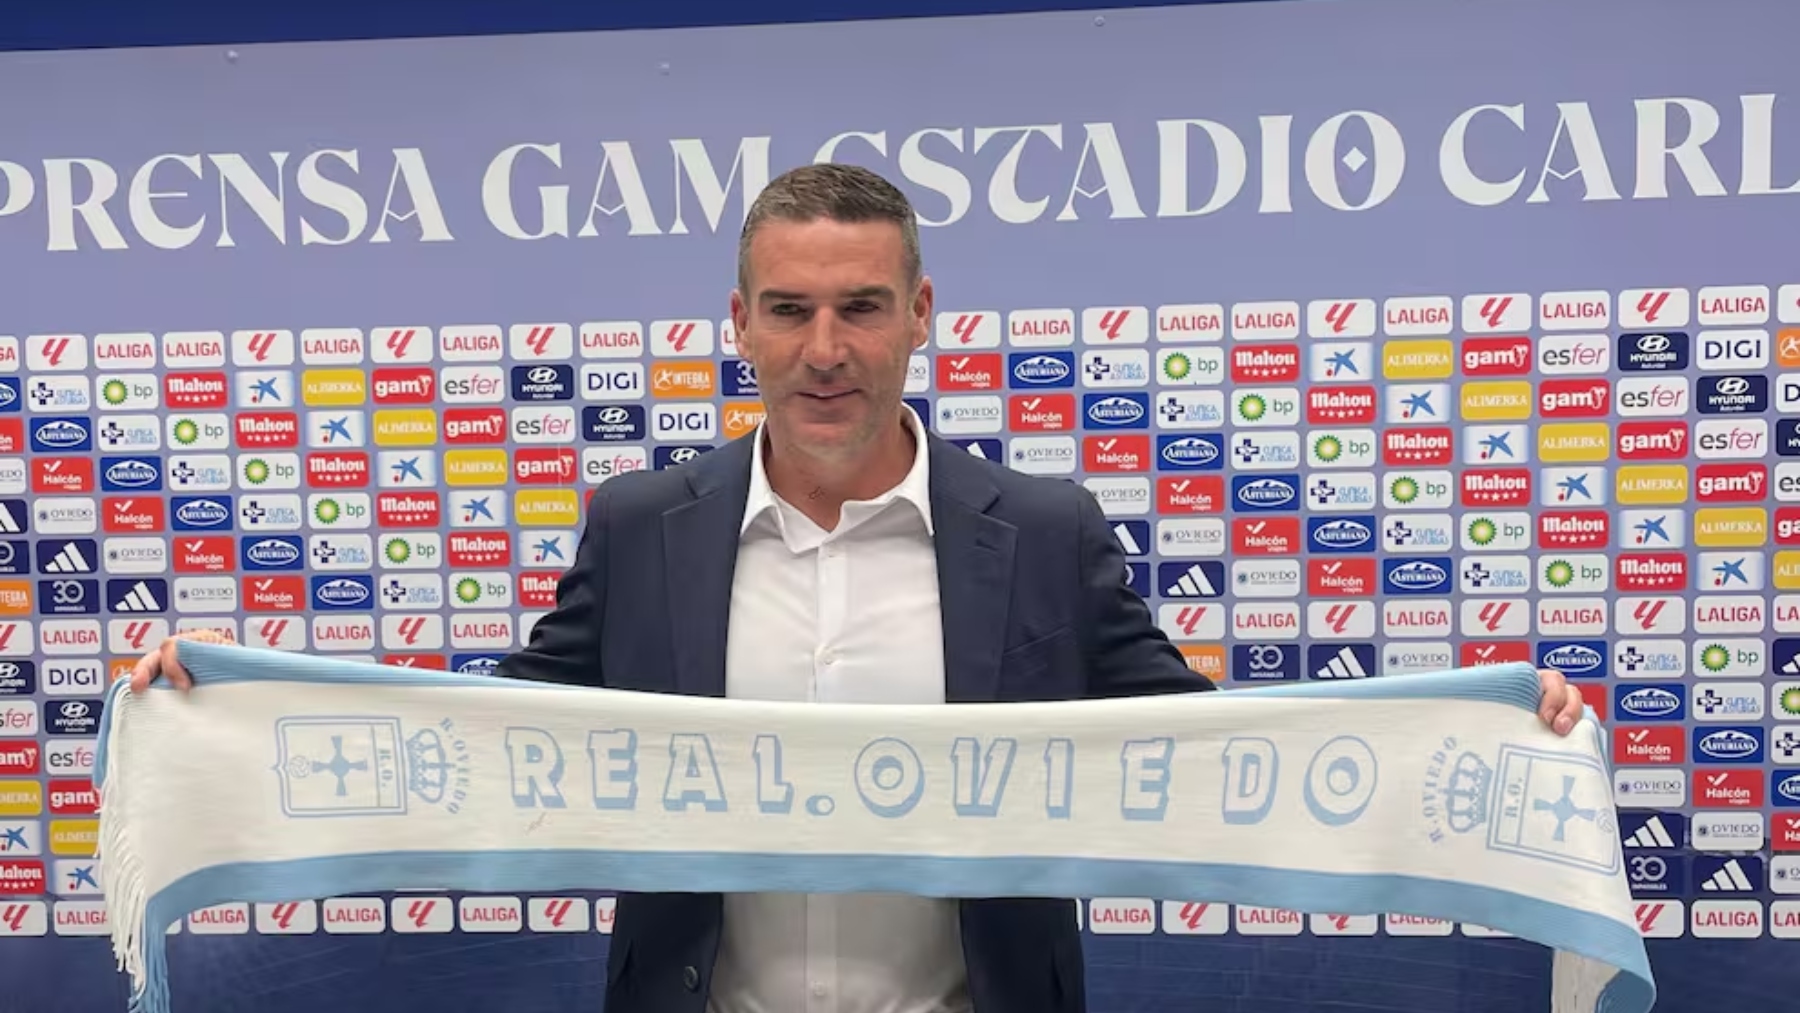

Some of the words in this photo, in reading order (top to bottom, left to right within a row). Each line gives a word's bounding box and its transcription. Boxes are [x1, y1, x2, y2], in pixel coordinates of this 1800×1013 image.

[482, 137, 771, 241] GAM
[1543, 303, 1606, 318] LALIGA
[1702, 297, 1765, 314] LALIGA
[1160, 315, 1220, 331] LALIGA
[1235, 313, 1295, 329] LALIGA
[1387, 308, 1449, 324] LALIGA
[1012, 320, 1071, 336] LALIGA
[304, 339, 360, 354] LALIGA
[443, 336, 499, 351] LALIGA
[583, 332, 639, 347] LALIGA
[97, 344, 153, 358] LALIGA
[166, 342, 222, 357] LALIGA
[1543, 343, 1606, 365] esfer
[1705, 340, 1760, 359] DIGI
[1236, 351, 1295, 366] Mahou
[1388, 354, 1449, 365] ALIMERKA
[1630, 352, 1677, 362] HYUNDAI
[1198, 358, 1218, 374] bp
[588, 372, 637, 390] DIGI
[950, 372, 990, 383] Halcón
[134, 385, 153, 399] bp
[168, 378, 223, 392] Mahou
[444, 375, 500, 395] esfer
[522, 383, 564, 392] HYUNDAI
[1311, 393, 1371, 407] Mahou
[1466, 395, 1527, 406] ALIMERKA
[1621, 384, 1684, 407] esfer
[1709, 395, 1755, 405] HYUNDAI
[954, 408, 999, 417] OVIEDO
[1273, 399, 1293, 415] bp
[239, 418, 294, 432] Mahou
[516, 415, 571, 435] esfer
[660, 413, 708, 430] DIGI
[1022, 413, 1062, 424] Halcón
[205, 424, 224, 439] bp
[593, 424, 635, 432] HYUNDAI
[1388, 434, 1448, 449] Mahou
[1542, 437, 1605, 448] ALIMERKA
[1699, 426, 1763, 450] esfer
[1027, 448, 1073, 459] OVIEDO
[1349, 441, 1370, 457] bp
[310, 458, 365, 472] Mahou
[587, 453, 642, 475] esfer
[1097, 454, 1138, 464] Halcón
[276, 464, 295, 479] bp
[43, 475, 82, 486] Halcón
[1465, 475, 1526, 490] Mahou
[1621, 479, 1684, 491] ALIMERKA
[1101, 489, 1147, 499] OVIEDO
[1426, 482, 1446, 497] bp
[381, 498, 436, 511] Mahou
[1170, 495, 1211, 506] Halcón
[51, 509, 93, 517] OVIEDO
[346, 503, 365, 518] bp
[115, 514, 153, 525] Halcón
[1543, 517, 1604, 532] Mahou
[1504, 523, 1524, 539] bp
[1700, 521, 1762, 533] ALIMERKA
[1176, 530, 1222, 540] OVIEDO
[1246, 536, 1287, 547] Halcón
[417, 543, 436, 558] bp
[451, 537, 506, 551] Mahou
[121, 548, 163, 558] OVIEDO
[185, 554, 224, 563] Halcón
[1581, 565, 1602, 581] bp
[1620, 559, 1682, 574] Mahou
[1250, 571, 1297, 580] OVIEDO
[1321, 577, 1363, 588] Halcón
[487, 583, 506, 597] bp
[522, 577, 557, 591] Mah
[53, 580, 84, 603] 30
[191, 588, 233, 596] OVIEDO
[255, 593, 293, 604] Halcón
[1236, 613, 1296, 628] LALIGA
[1387, 611, 1448, 626] LALIGA
[1541, 609, 1603, 624] LALIGA
[1698, 607, 1760, 622] LALIGA
[43, 630, 98, 644] LALIGA
[316, 626, 371, 640] LALIGA
[454, 624, 509, 638] LALIGA
[1249, 645, 1283, 669] 30
[1401, 654, 1450, 665] OVIEDO
[1738, 649, 1758, 666] bp
[49, 668, 96, 685] DIGI
[50, 747, 94, 767] esfe
[1626, 745, 1671, 757] Halcón
[0, 752, 26, 766] am
[1633, 781, 1681, 792] OVIEDO
[1707, 788, 1750, 800] Halcón
[1712, 824, 1760, 835] OVIEDO
[1631, 856, 1667, 881] 30
[190, 910, 245, 923] LALIGA
[327, 908, 381, 922] LALIGA
[463, 907, 518, 921] LALIGA
[1093, 908, 1151, 923] LALIGA
[1239, 910, 1300, 923] LALIGA
[1696, 912, 1758, 926] LALIGA
